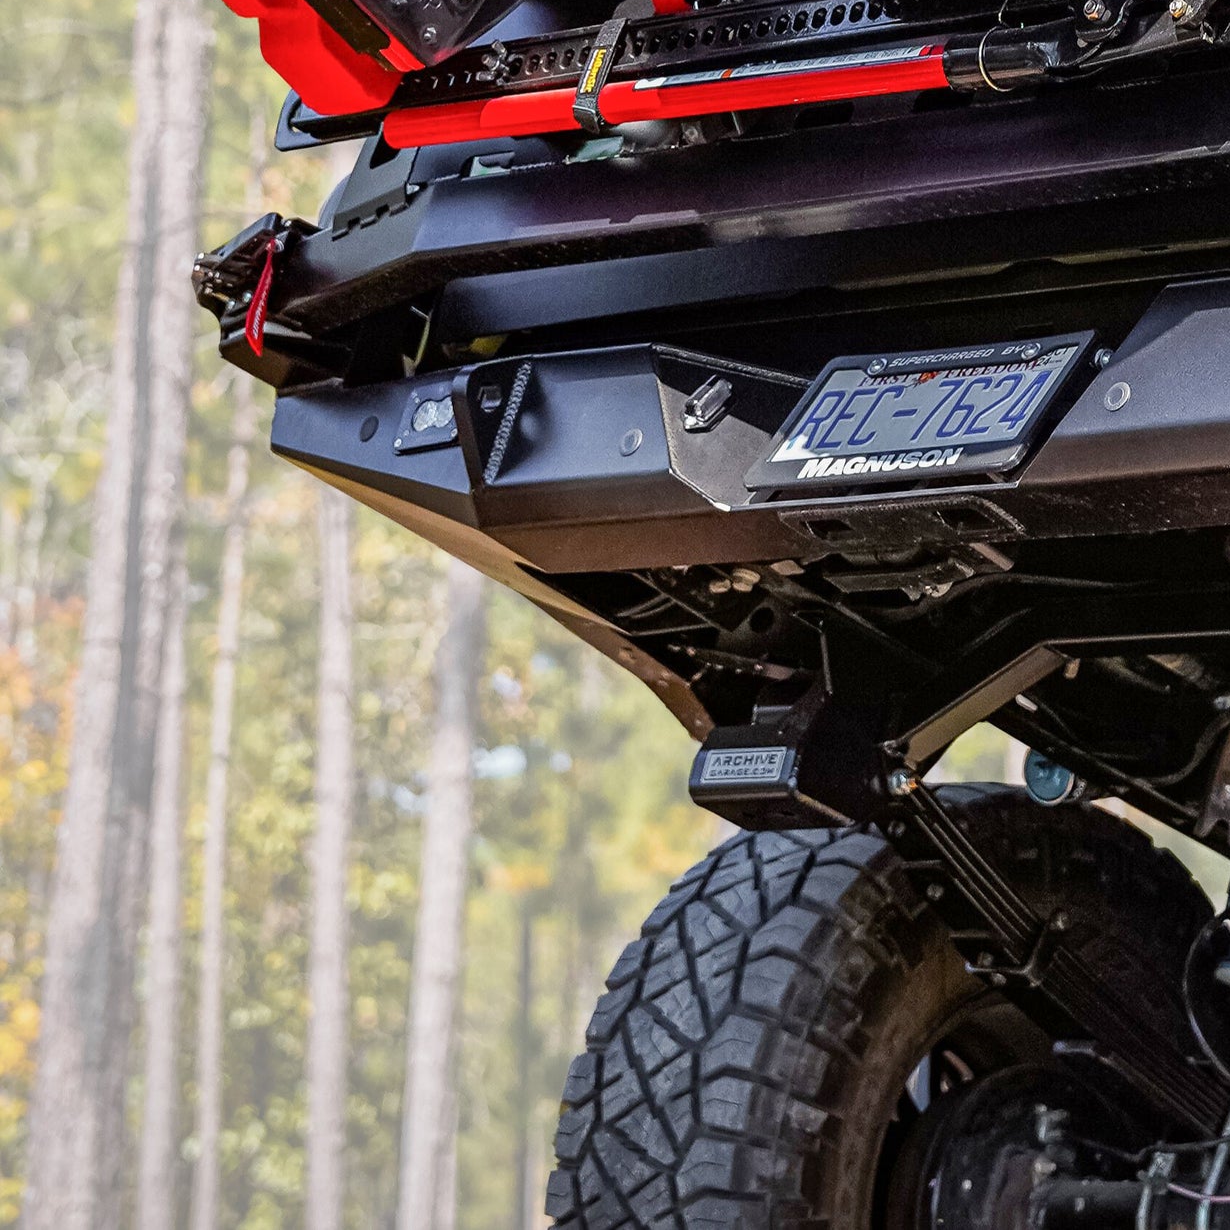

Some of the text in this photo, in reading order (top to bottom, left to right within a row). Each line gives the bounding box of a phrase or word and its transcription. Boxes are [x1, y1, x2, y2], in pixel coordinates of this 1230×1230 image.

[888, 344, 1026, 368] SUPERCHARGED BY
[786, 370, 1054, 450] REC-7624
[796, 446, 964, 480] MAGNUSON
[712, 753, 779, 767] ARCHIVE
